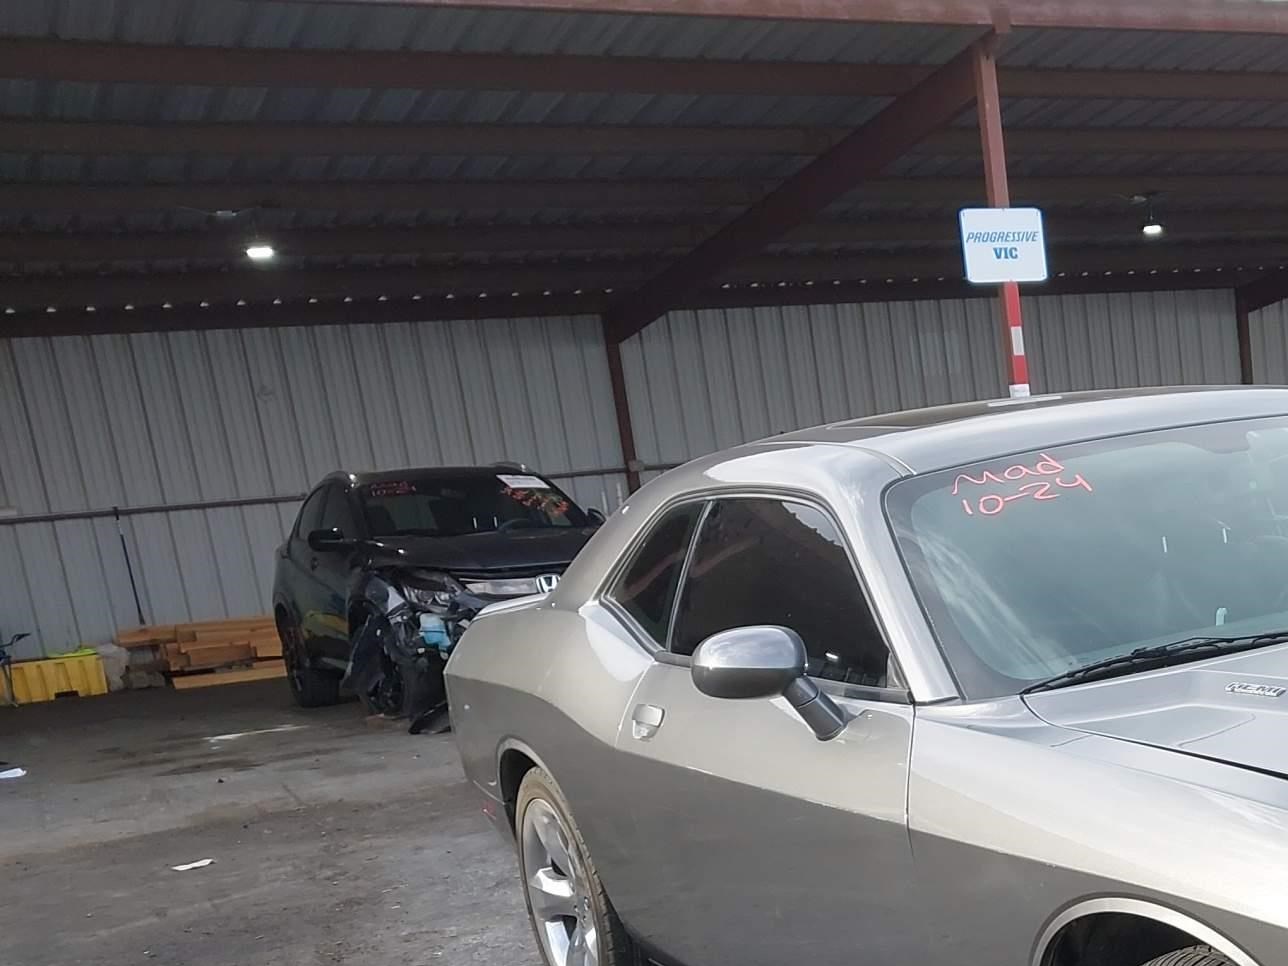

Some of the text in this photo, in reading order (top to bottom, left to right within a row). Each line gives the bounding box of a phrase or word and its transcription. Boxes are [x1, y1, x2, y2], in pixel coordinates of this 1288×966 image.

[966, 231, 1040, 243] PROGRESSIVE
[993, 246, 1019, 260] VIC
[961, 474, 1093, 515] 10-24
